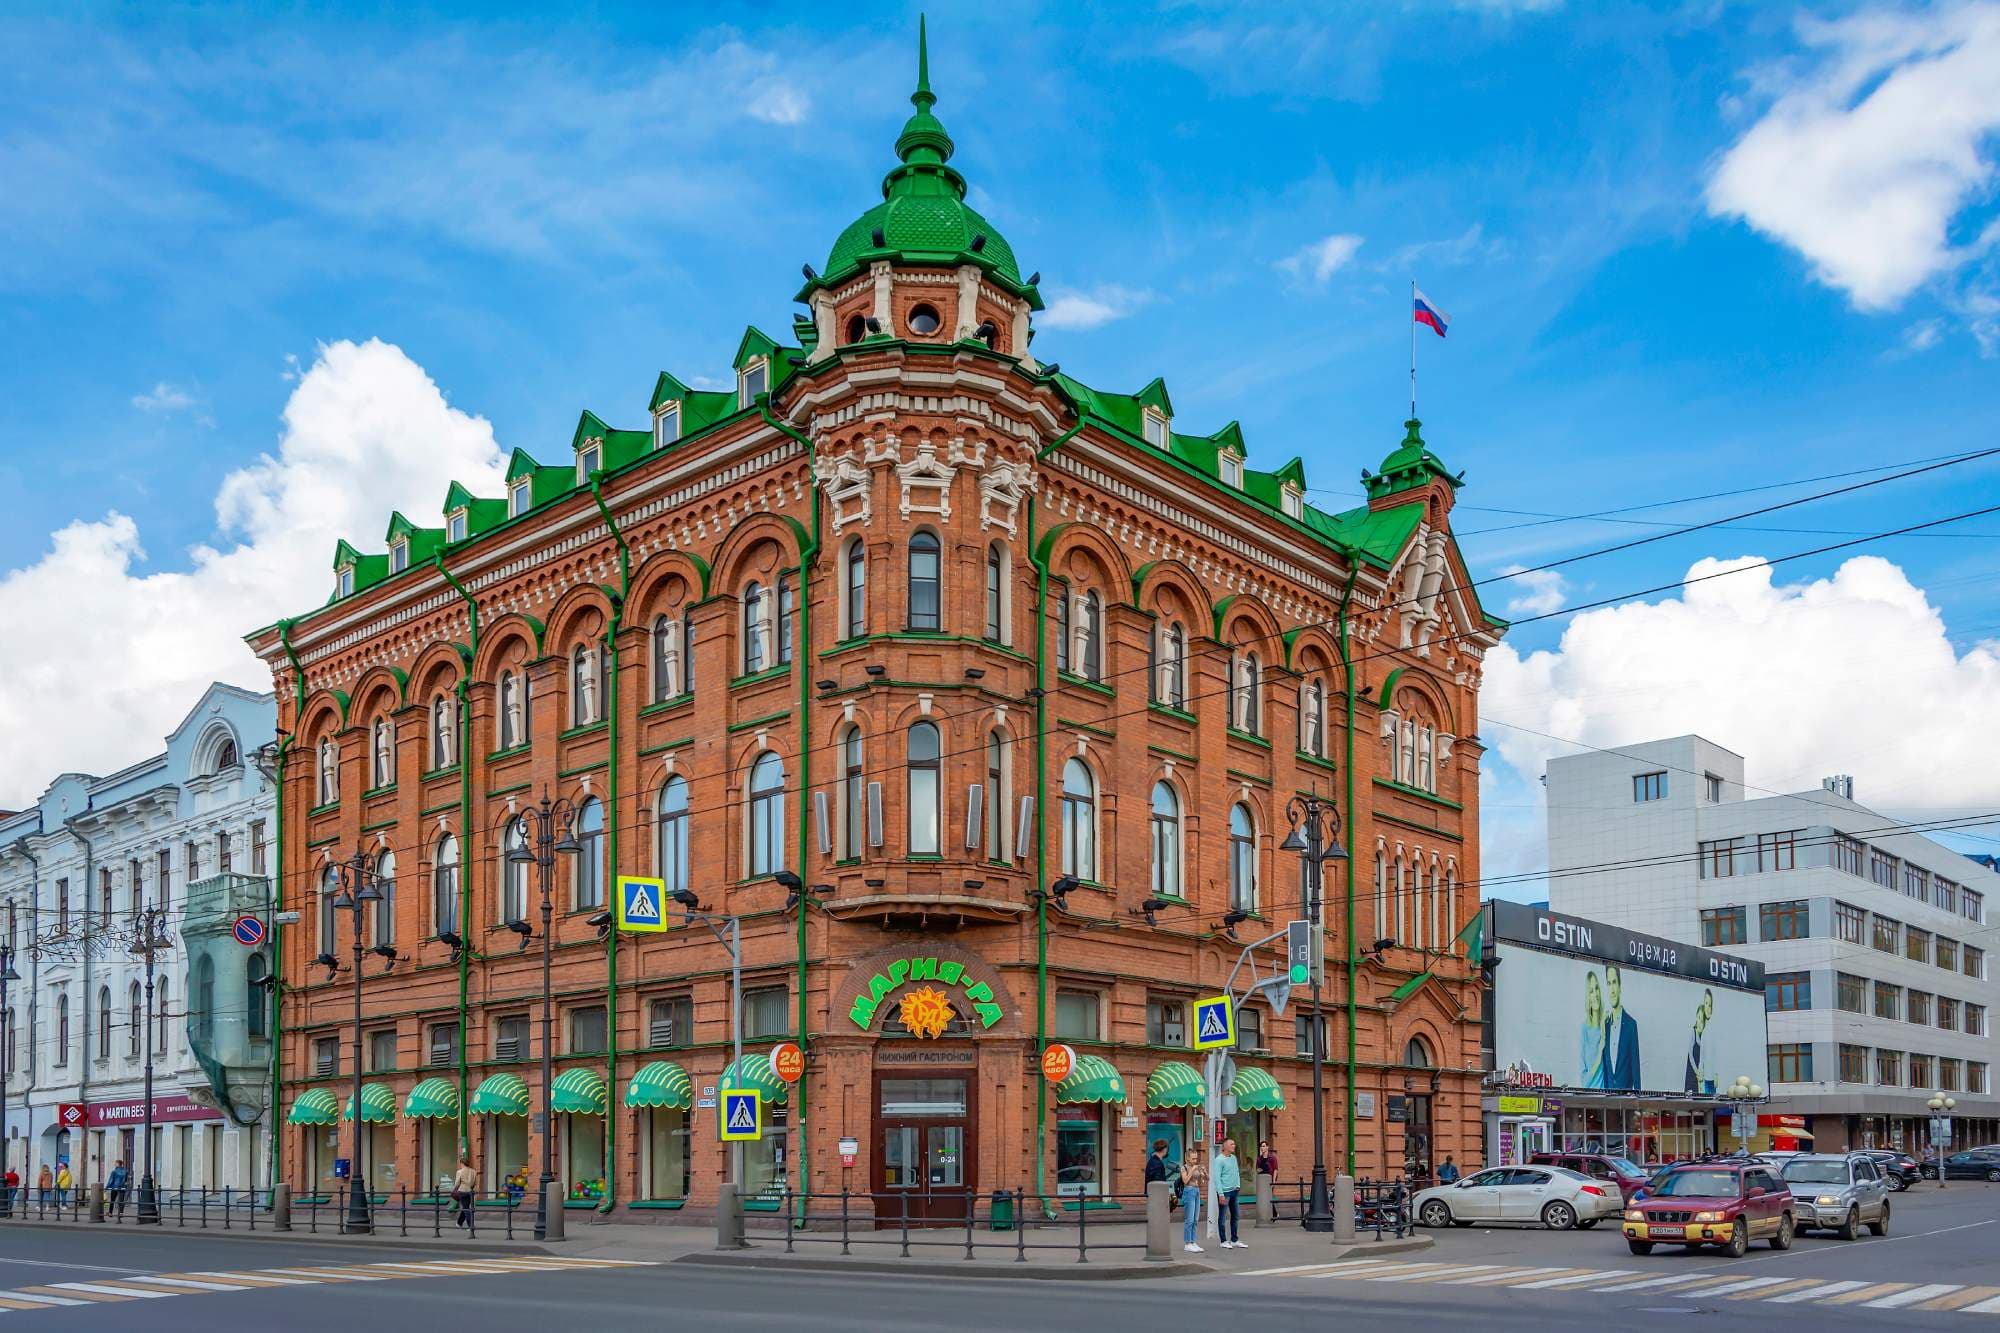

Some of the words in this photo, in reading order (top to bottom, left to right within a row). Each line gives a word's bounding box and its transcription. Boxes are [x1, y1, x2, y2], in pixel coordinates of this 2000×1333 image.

[1629, 940, 1676, 965] одежда
[849, 957, 1003, 1031] МАРИЯ-РА
[780, 1051, 800, 1065] 24
[878, 1052, 917, 1062] НИЖНИЙ
[919, 1052, 973, 1062] ГАСТРОНОМ
[1045, 1051, 1066, 1066] 24
[1520, 1072, 1552, 1088] ЦВЕТЫ
